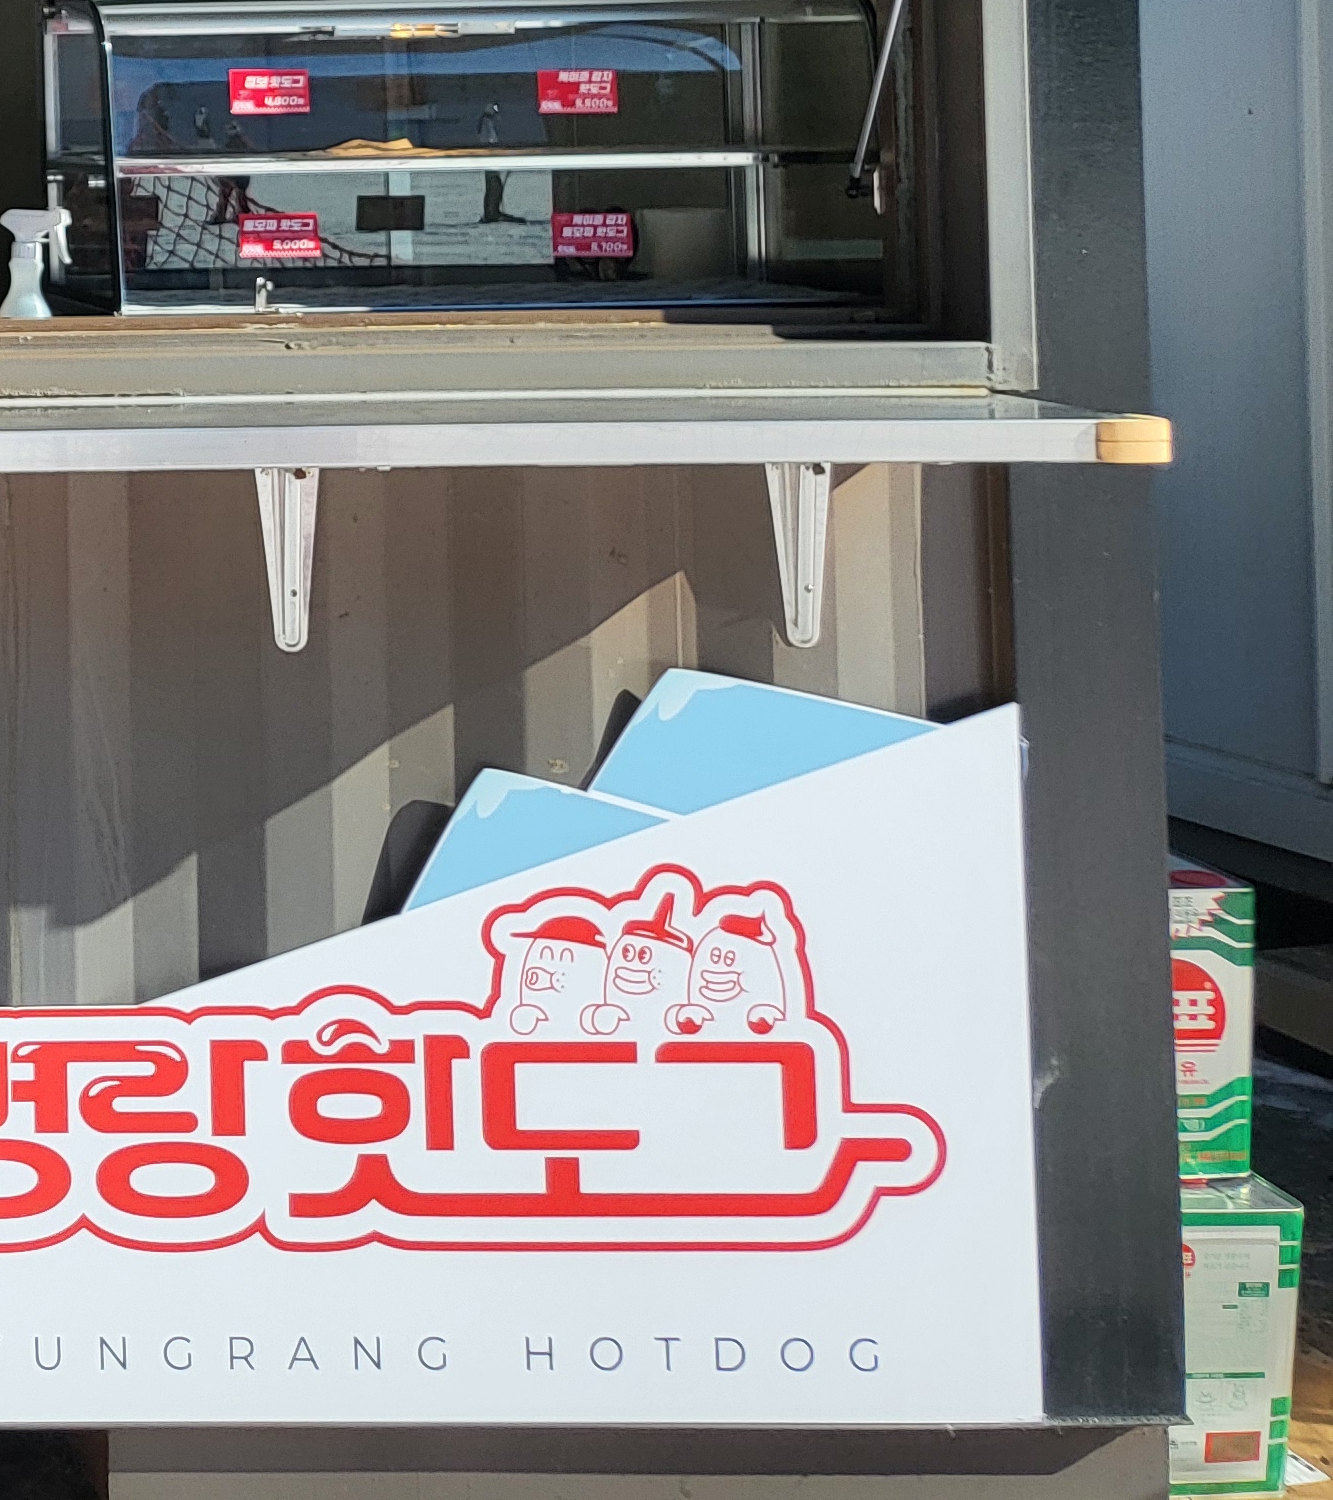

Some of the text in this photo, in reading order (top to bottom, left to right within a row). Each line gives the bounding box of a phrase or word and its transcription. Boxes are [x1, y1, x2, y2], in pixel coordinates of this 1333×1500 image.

[269, 75, 305, 88] 핫도그
[279, 218, 315, 231] 핫도그
[524, 1336, 880, 1372] HOTDOG
